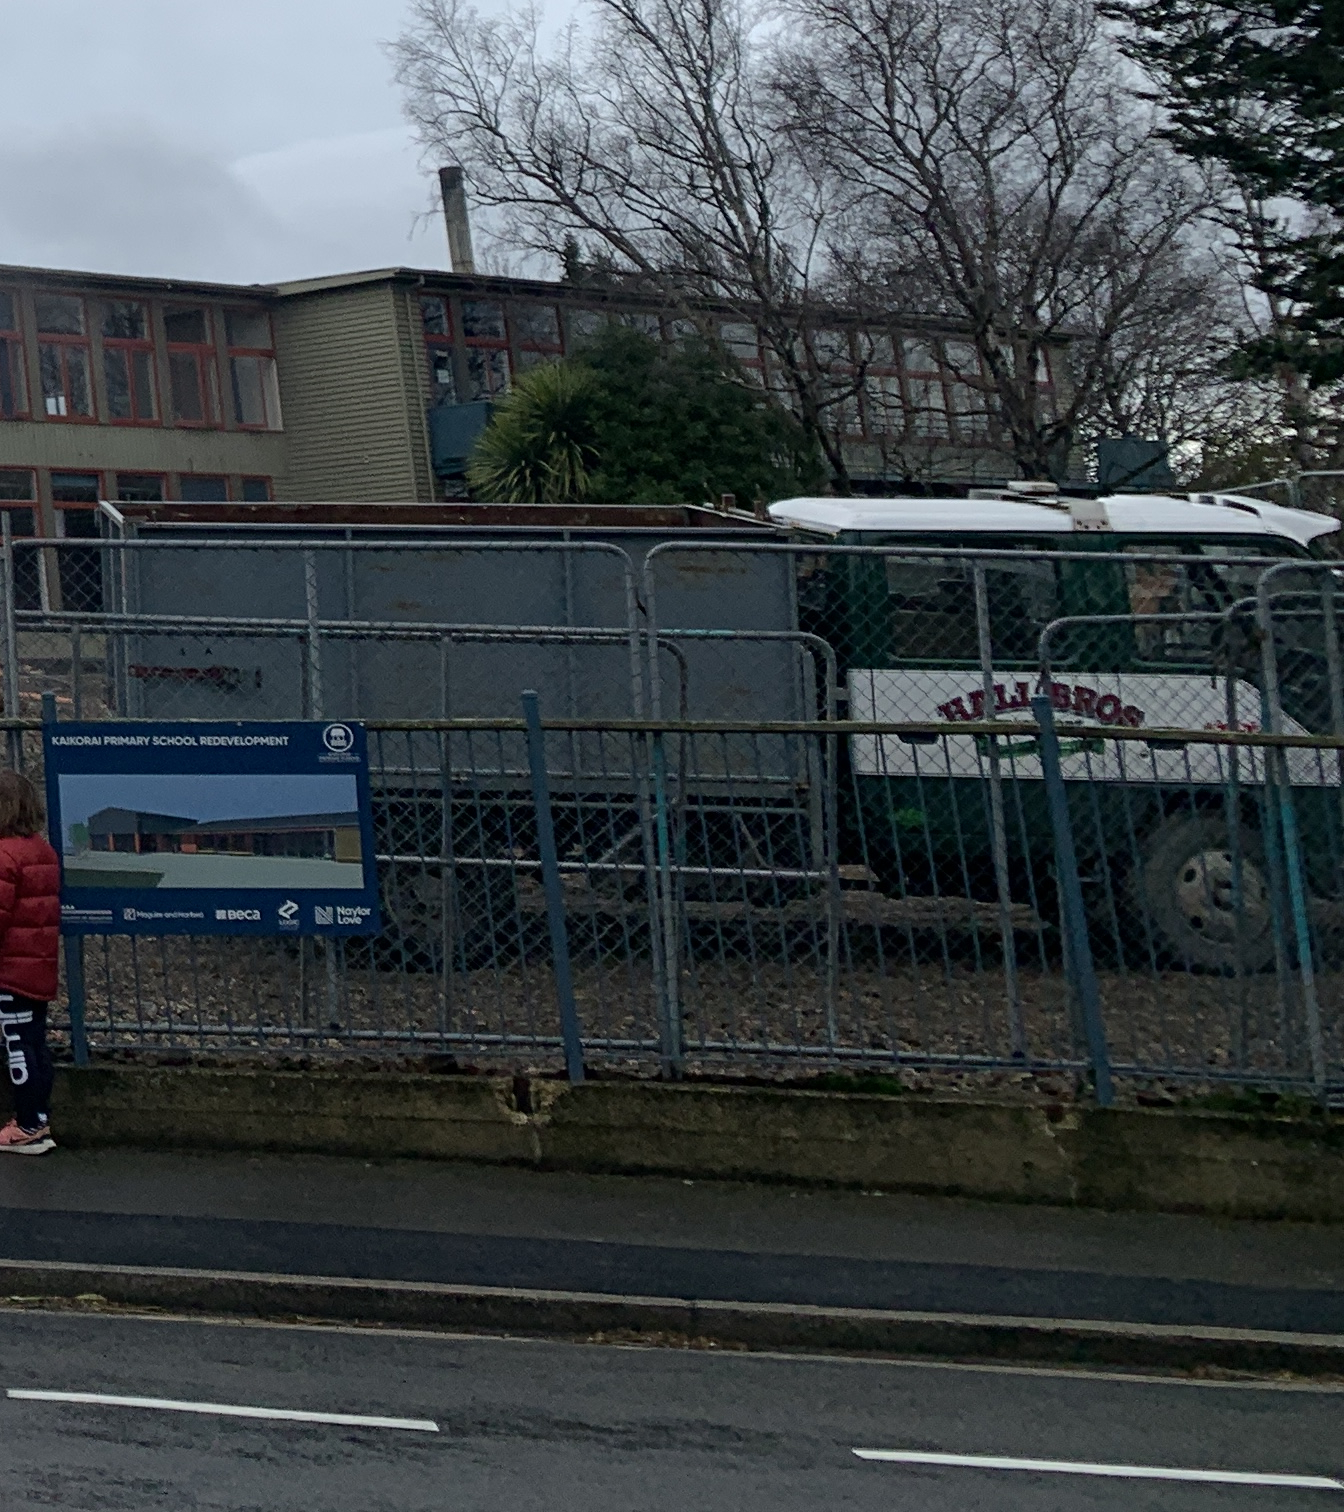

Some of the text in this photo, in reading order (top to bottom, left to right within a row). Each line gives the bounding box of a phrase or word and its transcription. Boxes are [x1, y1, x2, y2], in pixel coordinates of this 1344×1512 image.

[51, 736, 289, 746] KAIKORAI PRIMARY SCHOOL REDEVELOPMENT
[337, 906, 371, 916] Naylor
[337, 915, 363, 925] Love
